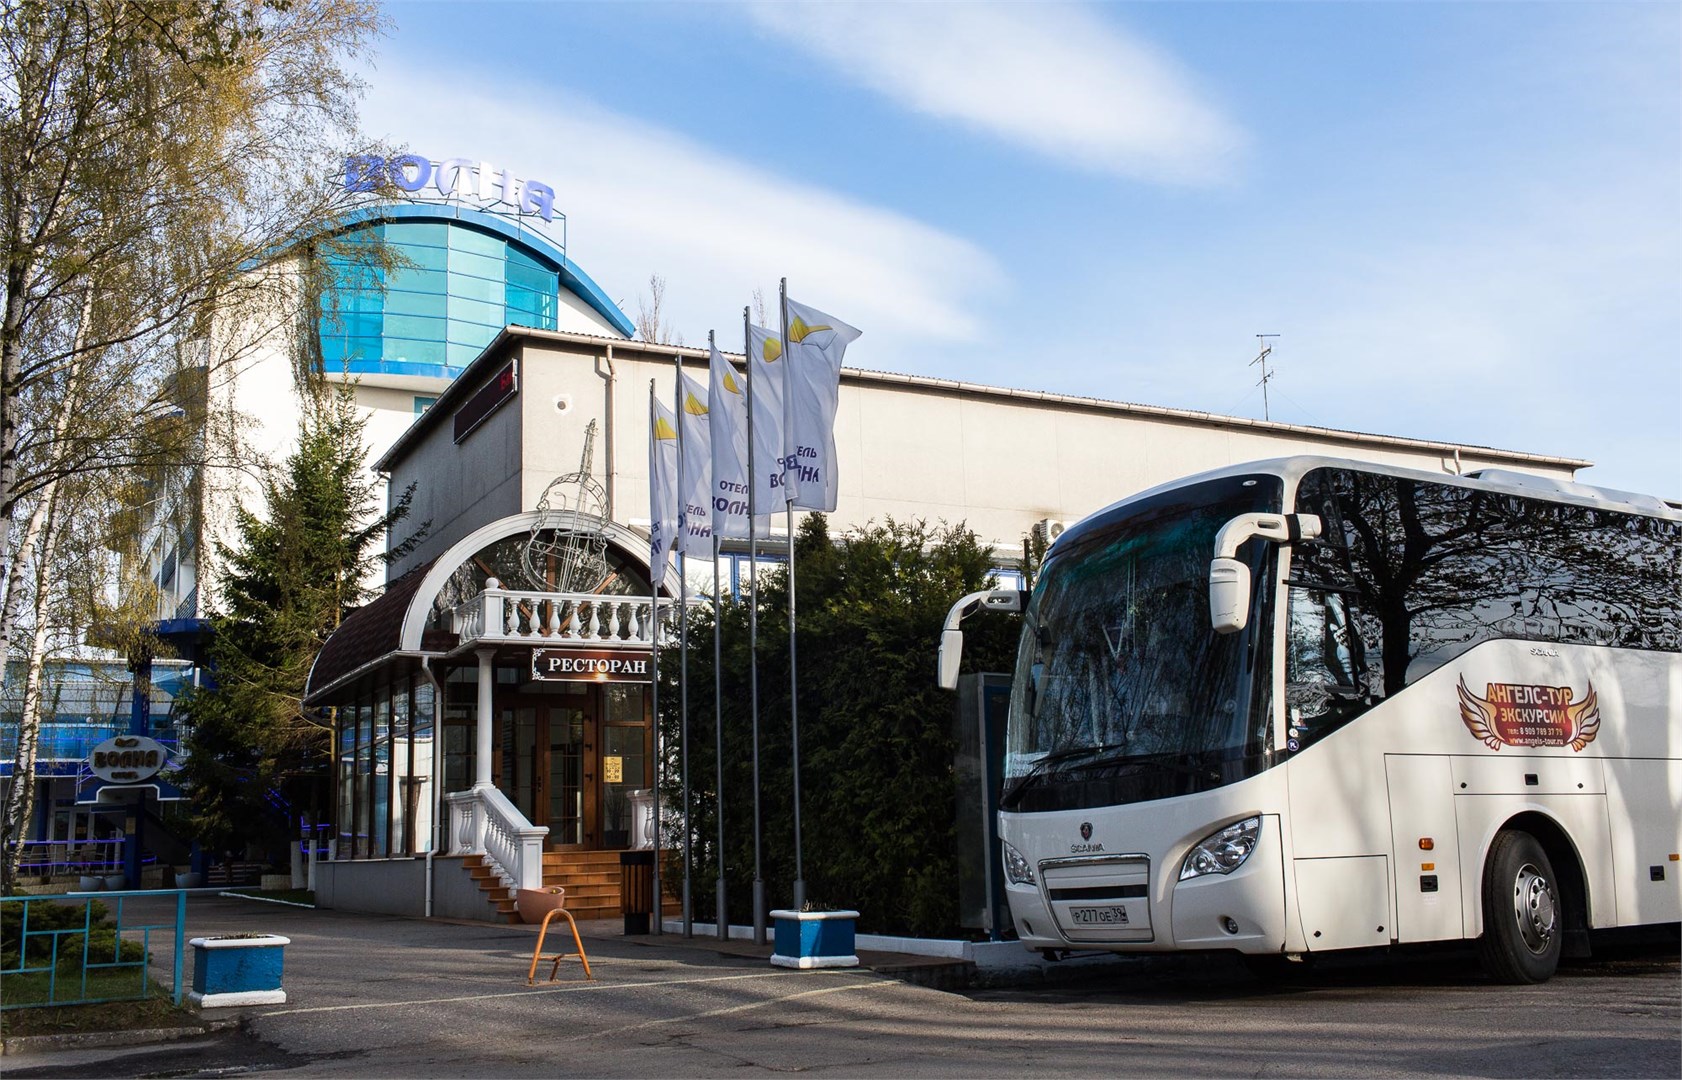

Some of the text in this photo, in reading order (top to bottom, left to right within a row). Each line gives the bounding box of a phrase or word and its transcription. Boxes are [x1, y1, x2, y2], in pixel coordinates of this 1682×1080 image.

[796, 445, 817, 458] ЕЛЬ
[720, 480, 749, 494] ОТЕЛ
[686, 503, 706, 516] ЕЛЬ
[1530, 647, 1559, 657] SCANIA
[548, 657, 647, 674] РЕСТОРАН
[1487, 684, 1572, 705] АНГЕЛС-ТУР
[1501, 707, 1566, 724] ЭКСКУРСИИ
[1519, 727, 1524, 735] 8
[1524, 727, 1536, 736] 909
[1548, 728, 1555, 736] 37
[1509, 737, 1564, 746] www.angels-tour.ru
[1070, 843, 1105, 853] SCANIA
